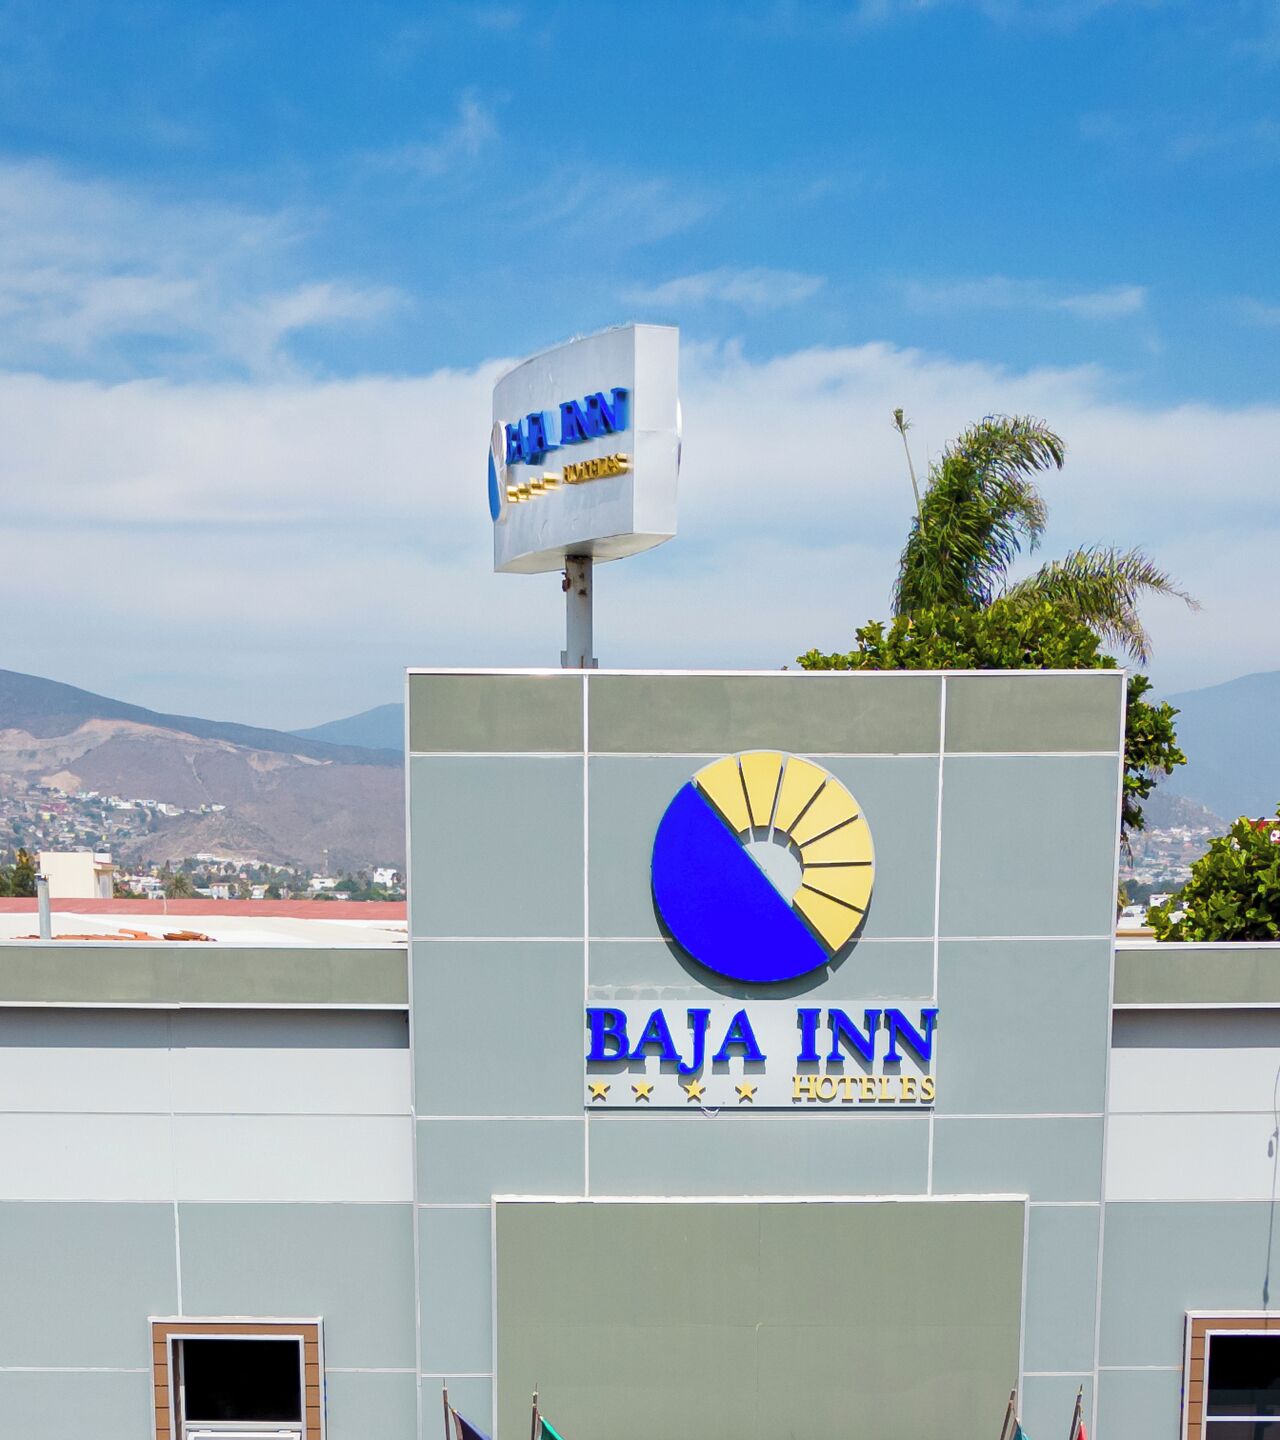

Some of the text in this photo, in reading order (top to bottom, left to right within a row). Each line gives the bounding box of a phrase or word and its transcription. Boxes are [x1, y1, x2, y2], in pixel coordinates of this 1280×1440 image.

[586, 1008, 940, 1075] BAJA INN
[792, 1075, 936, 1103] HOTELES
